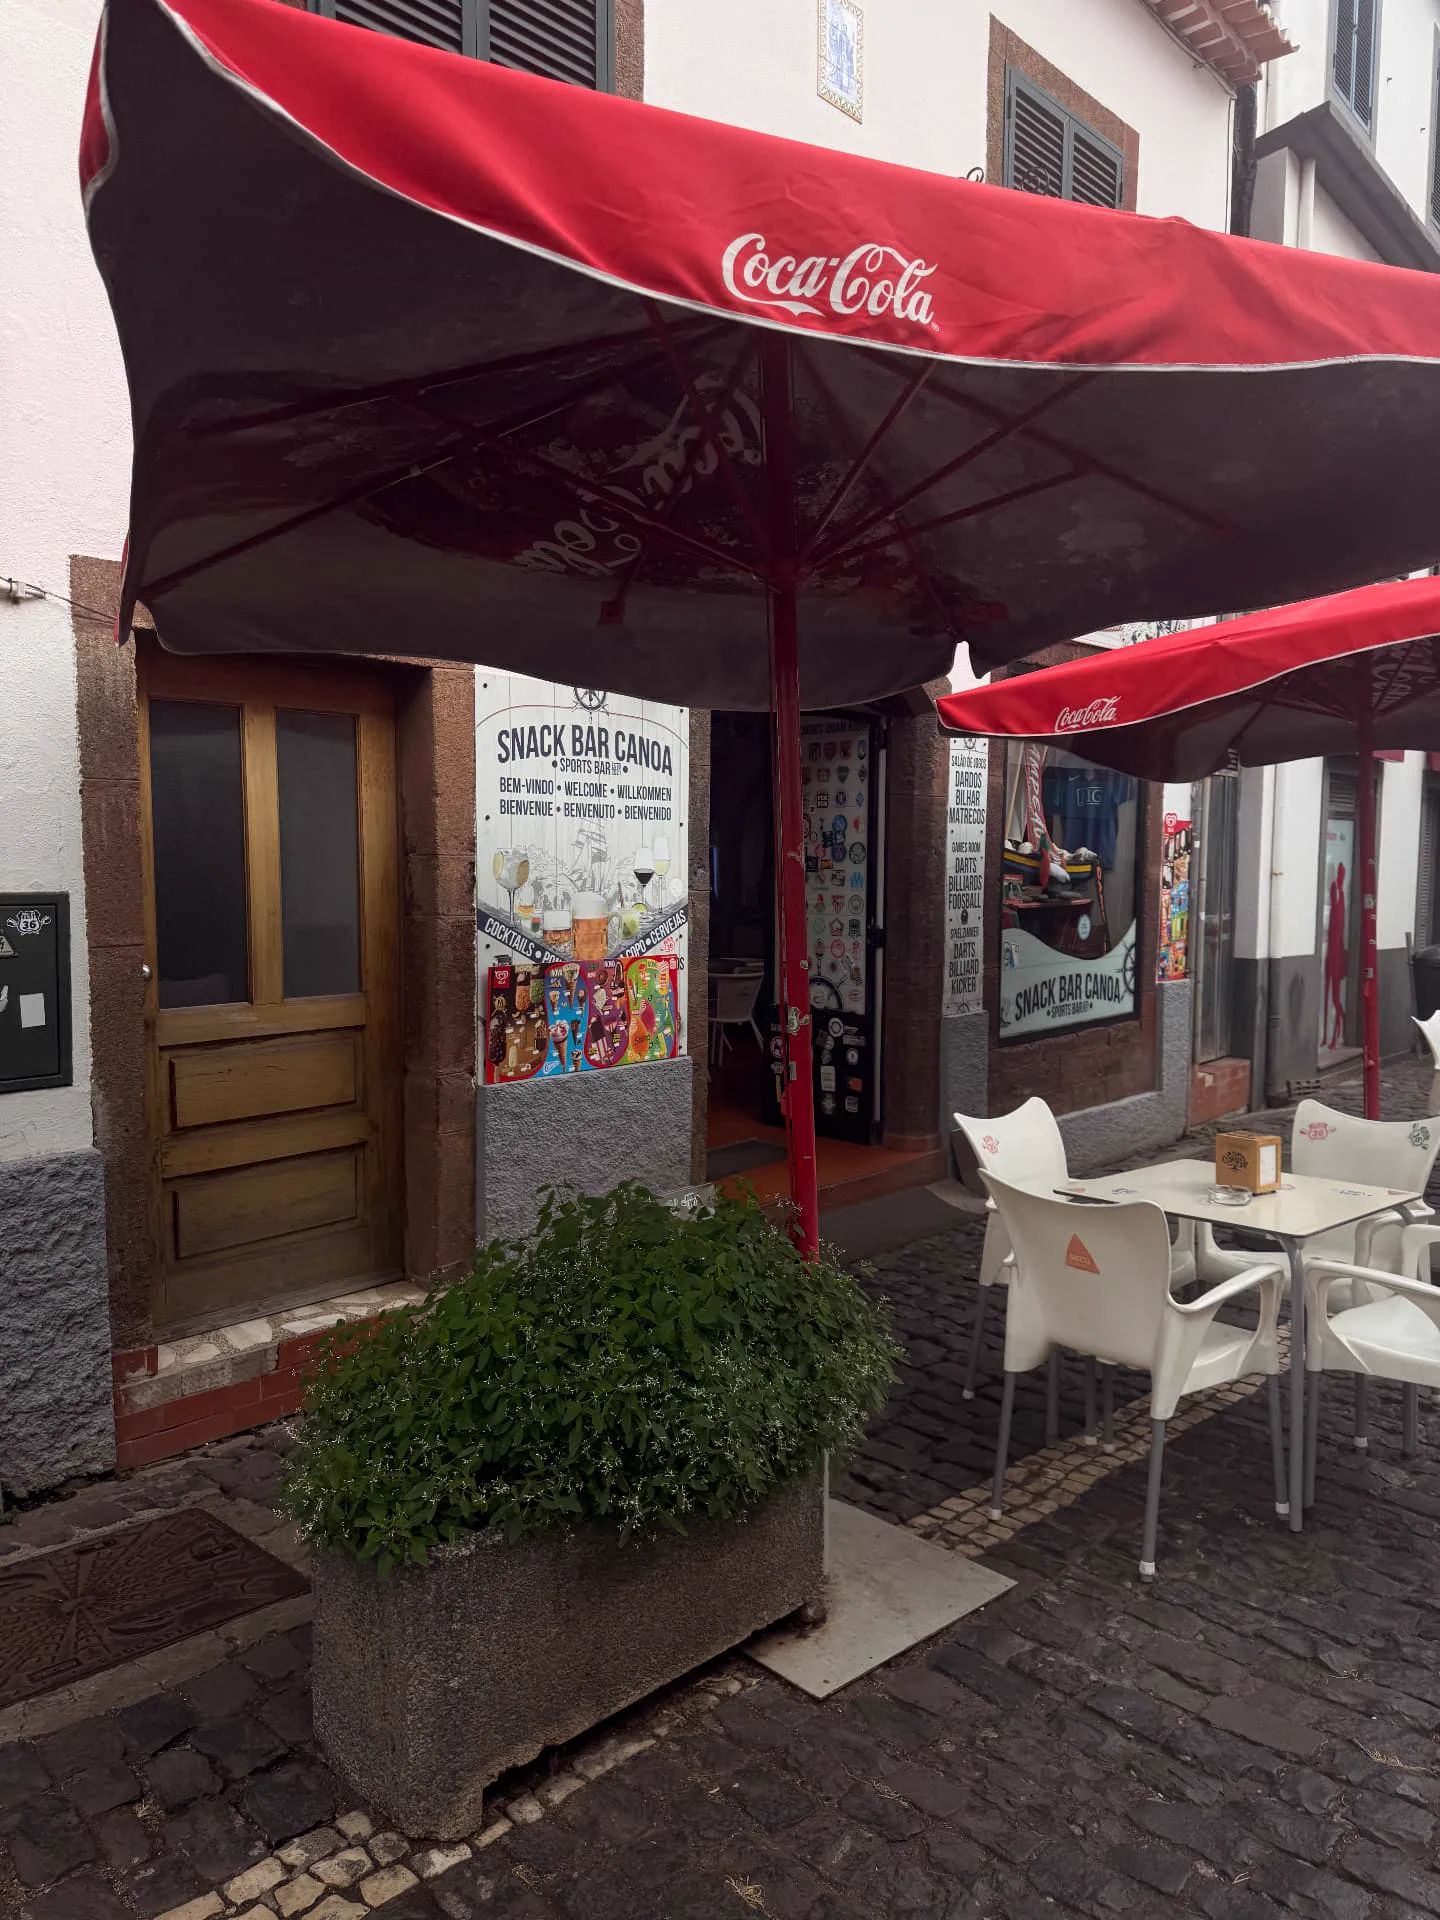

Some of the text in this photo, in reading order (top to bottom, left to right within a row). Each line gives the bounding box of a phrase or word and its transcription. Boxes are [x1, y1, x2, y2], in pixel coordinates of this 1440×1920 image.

[721, 232, 939, 326] Coca-Cola
[1054, 695, 1122, 733] Coca-Cola
[497, 724, 673, 776] SNACK BAR CANOA
[559, 757, 592, 774] SPORTS
[594, 761, 611, 775] BAR
[967, 758, 973, 768] DE
[955, 771, 983, 788] DARDOS
[499, 777, 672, 801] BEM-VINDO WELCOME WILLKOMMEN
[955, 789, 981, 807] BILHAR
[499, 799, 672, 821] BIENVENUE BENVENUTO BIENVENIDO
[949, 808, 986, 825] MATRECOS
[955, 857, 977, 873] DARTS
[949, 875, 983, 892] BILLIARDS
[949, 892, 981, 911] FOOSBALL
[23, 920, 37, 929] 36
[650, 909, 687, 944] CERVEJAS
[484, 917, 536, 959] COCKTAILS
[953, 942, 976, 959] DARTS
[949, 959, 979, 977] BILLIARD
[951, 977, 977, 995] KICKER
[1015, 977, 1056, 1021] SNACK
[1059, 973, 1082, 1002] BAR
[1085, 973, 1120, 1004] CANOA
[1051, 1003, 1071, 1018] SPORTS
[1072, 1002, 1083, 1015] BAR
